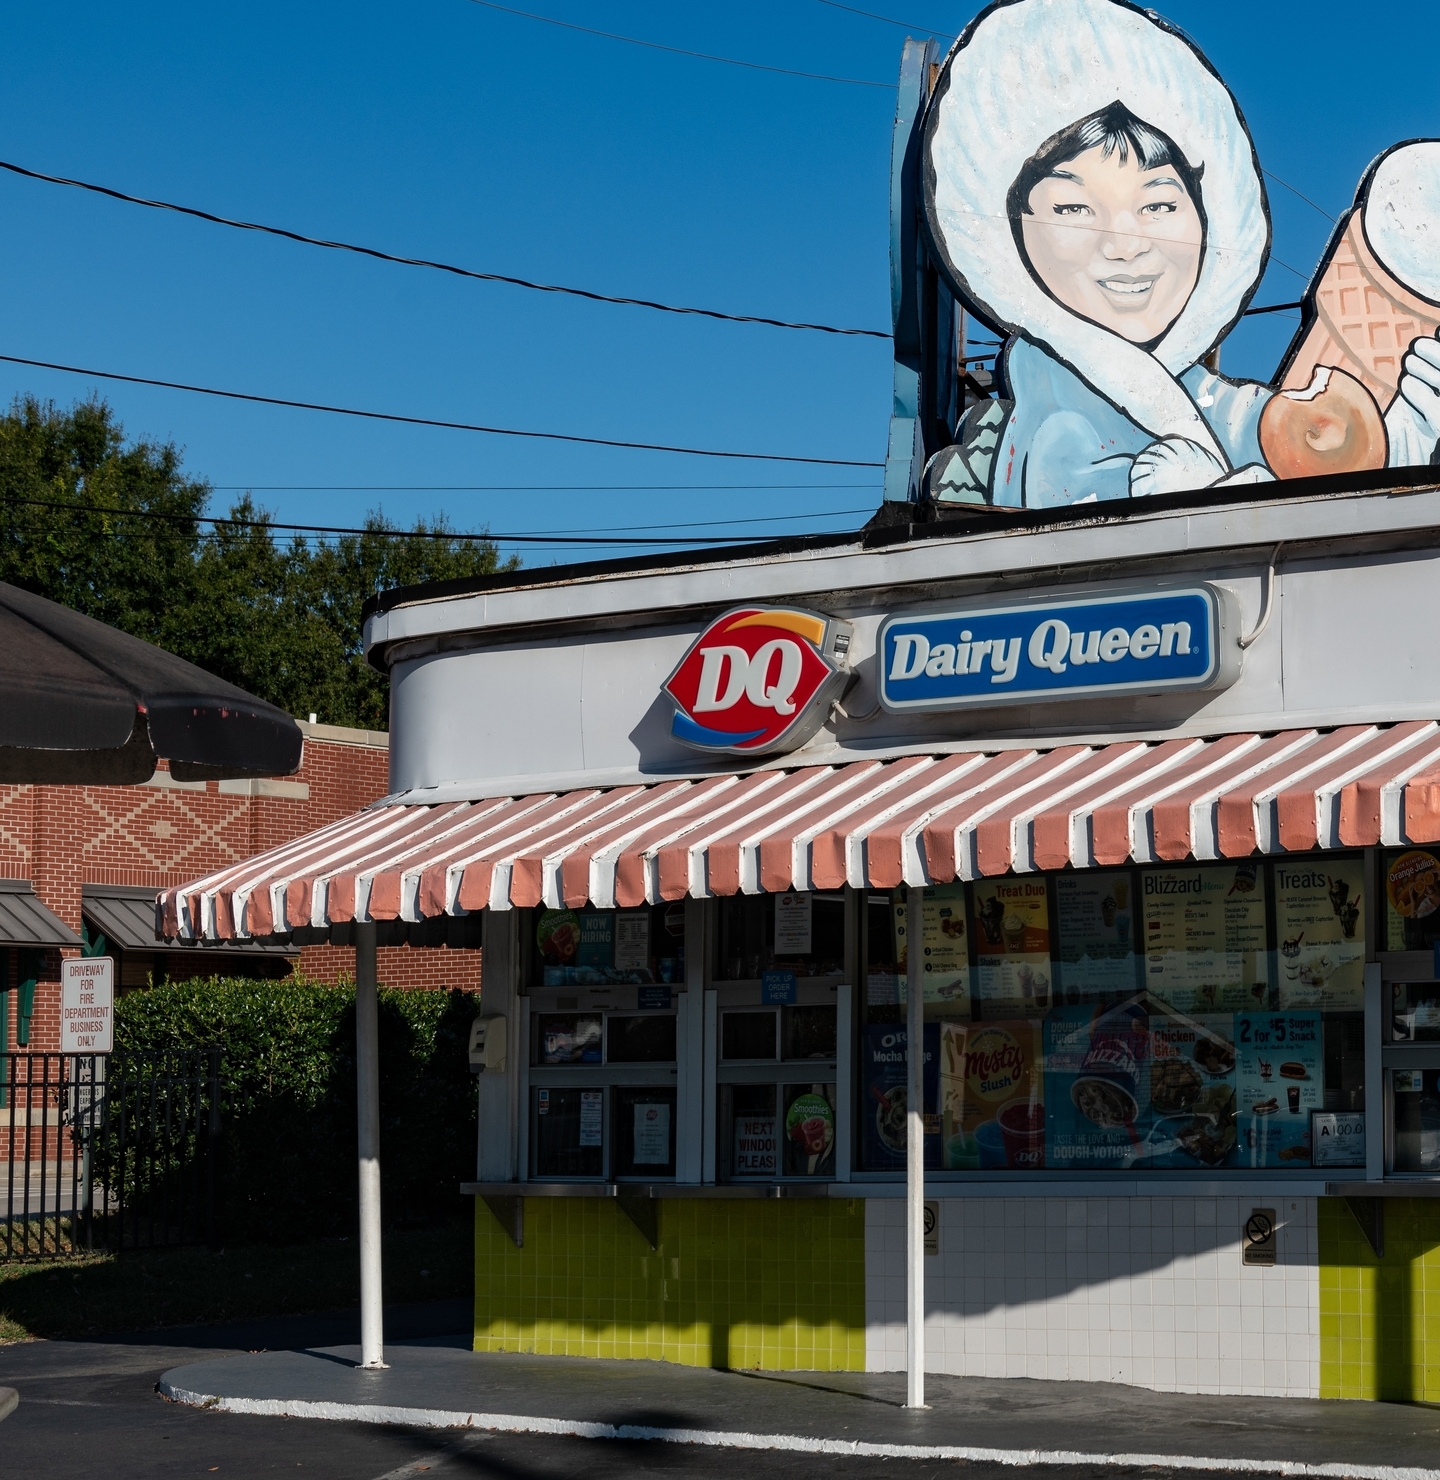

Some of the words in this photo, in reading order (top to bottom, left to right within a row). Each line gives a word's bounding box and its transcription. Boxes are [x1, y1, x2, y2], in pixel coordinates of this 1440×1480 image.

[889, 631, 1022, 683] Dairy
[1026, 619, 1193, 674] Queen
[692, 639, 803, 715] DQ
[1390, 868, 1414, 882] Orange
[1415, 858, 1435, 872] Julius
[1058, 880, 1077, 889] Drinks
[1144, 874, 1202, 894] Blizzard
[1200, 882, 1224, 891] Menu
[1277, 870, 1326, 889] Treats
[996, 885, 1023, 898] Treat
[1025, 884, 1045, 897] Duo
[541, 911, 573, 929] Smoothies
[585, 917, 608, 930] NOW
[581, 931, 611, 943] HIRING
[980, 957, 1000, 966] Shakes
[70, 965, 105, 977] DRIVEWAY
[80, 980, 94, 990] FOR
[80, 993, 94, 1004] FIRE
[770, 992, 788, 1000] HERE
[65, 1007, 109, 1019] DEPARTMENT
[70, 1021, 103, 1033] BUSINESS
[1051, 1022, 1082, 1033] DOUBLE
[1168, 1021, 1205, 1029] Rotisse-style
[1240, 1018, 1251, 1042] 2
[1254, 1029, 1270, 1042] for
[1270, 1018, 1286, 1042] $5
[1289, 1018, 1315, 1031] Super
[78, 1036, 96, 1047] ONLY
[881, 1031, 907, 1048] OR
[971, 1033, 983, 1048] Flavor
[1051, 1033, 1078, 1044] FUDGE
[1154, 1030, 1195, 1043] Chicken
[1289, 1031, 1316, 1041] Snack
[873, 1050, 903, 1062] Mocha
[1154, 1044, 1181, 1056] Bites
[964, 1043, 1025, 1080] Misty
[981, 1076, 1012, 1093] Slush
[794, 1103, 828, 1115] Smoothies
[745, 1122, 774, 1135] NEXT
[1321, 1126, 1330, 1136] A
[1333, 1124, 1363, 1136] 100.0
[1054, 1134, 1072, 1144] TASTE
[1075, 1134, 1087, 1144] THE
[1088, 1134, 1104, 1144] LOVE
[1018, 1152, 1038, 1162] DQ
[1054, 1145, 1130, 1158] DOUGH-VOTION
[738, 1156, 776, 1168] PLEAS
